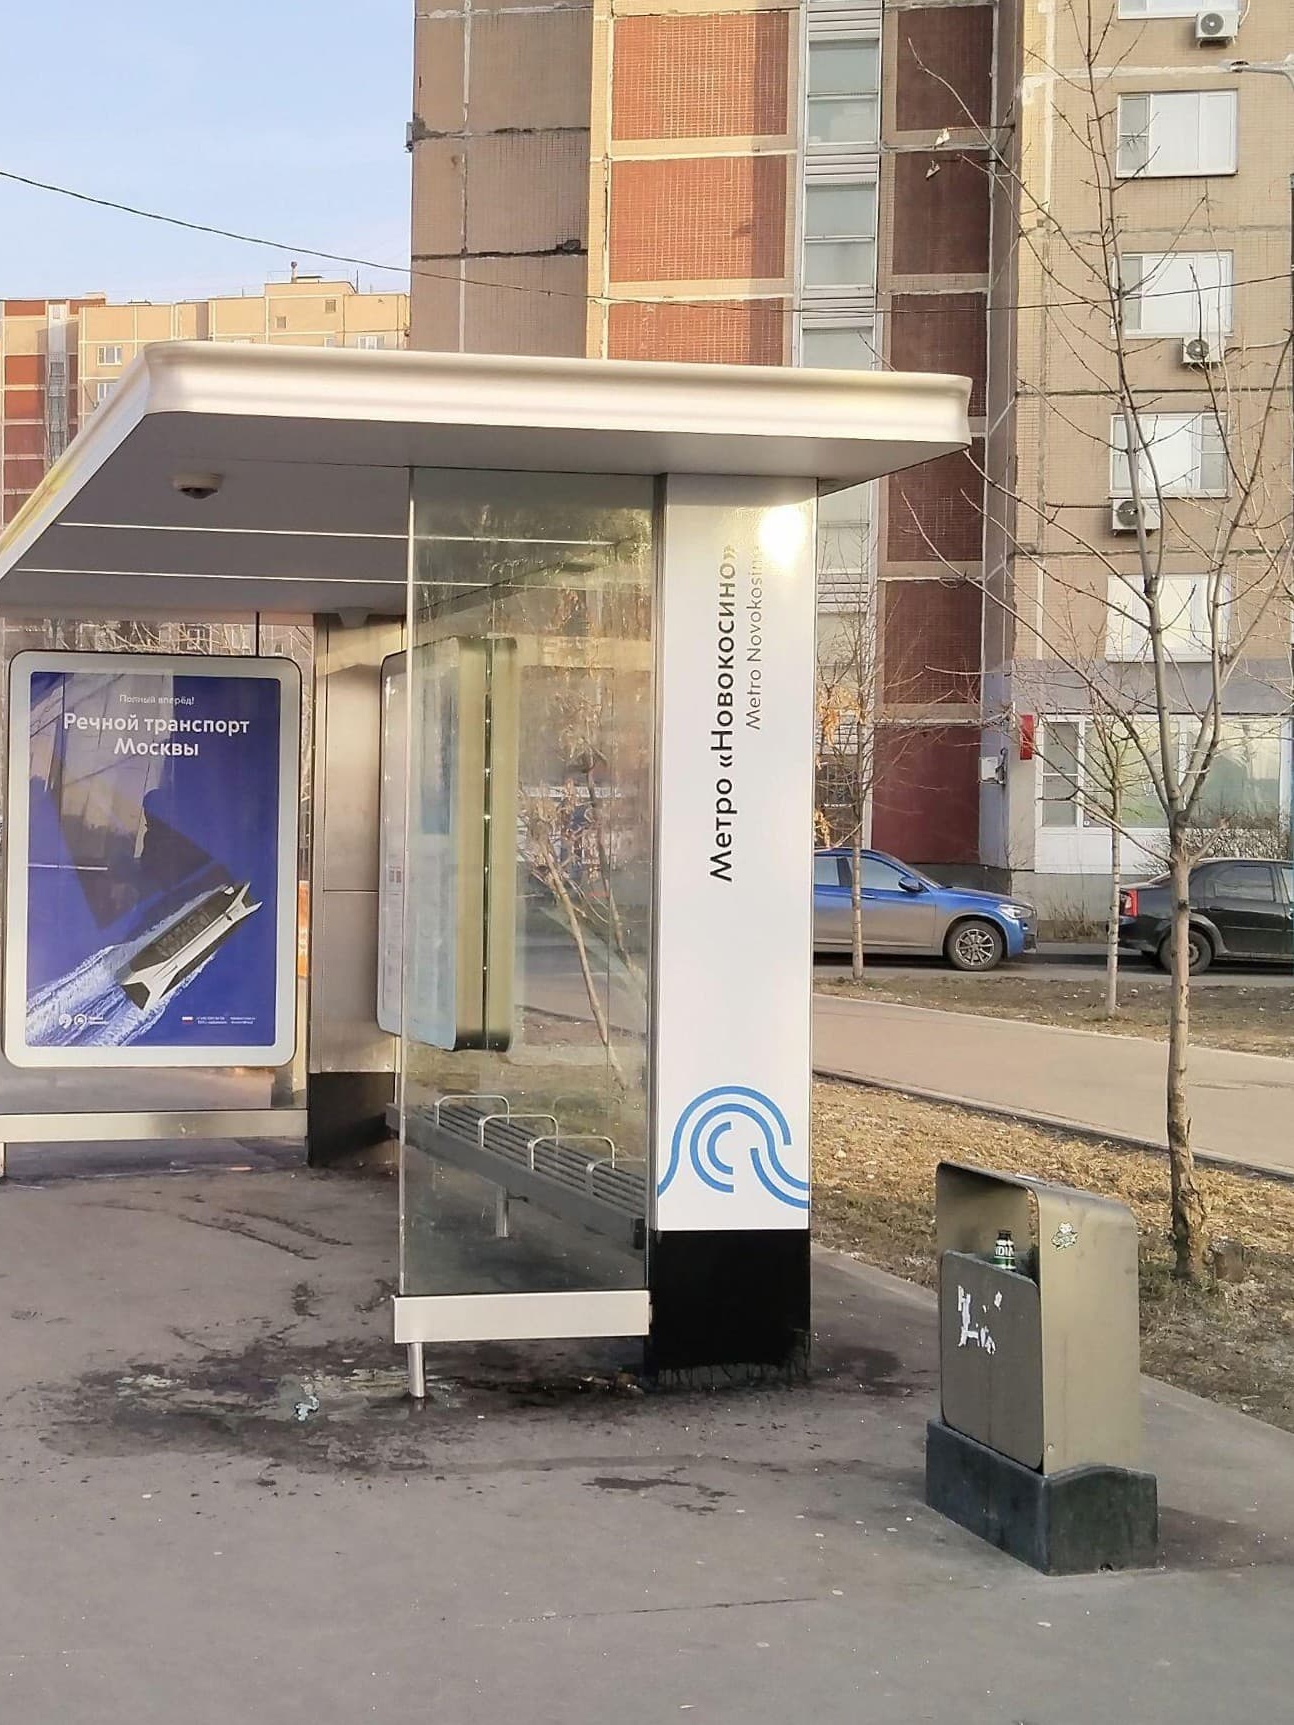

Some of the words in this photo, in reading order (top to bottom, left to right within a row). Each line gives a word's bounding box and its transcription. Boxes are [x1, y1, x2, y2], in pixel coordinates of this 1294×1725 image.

[710, 545, 737, 768] «Новокосино»
[119, 694, 156, 704] Полный
[158, 696, 195, 706] вперёд!
[746, 669, 762, 730] Metro
[64, 712, 139, 731] Речной
[144, 718, 250, 736] транспорт
[114, 738, 199, 756] Москвы
[710, 778, 737, 882] Метро
